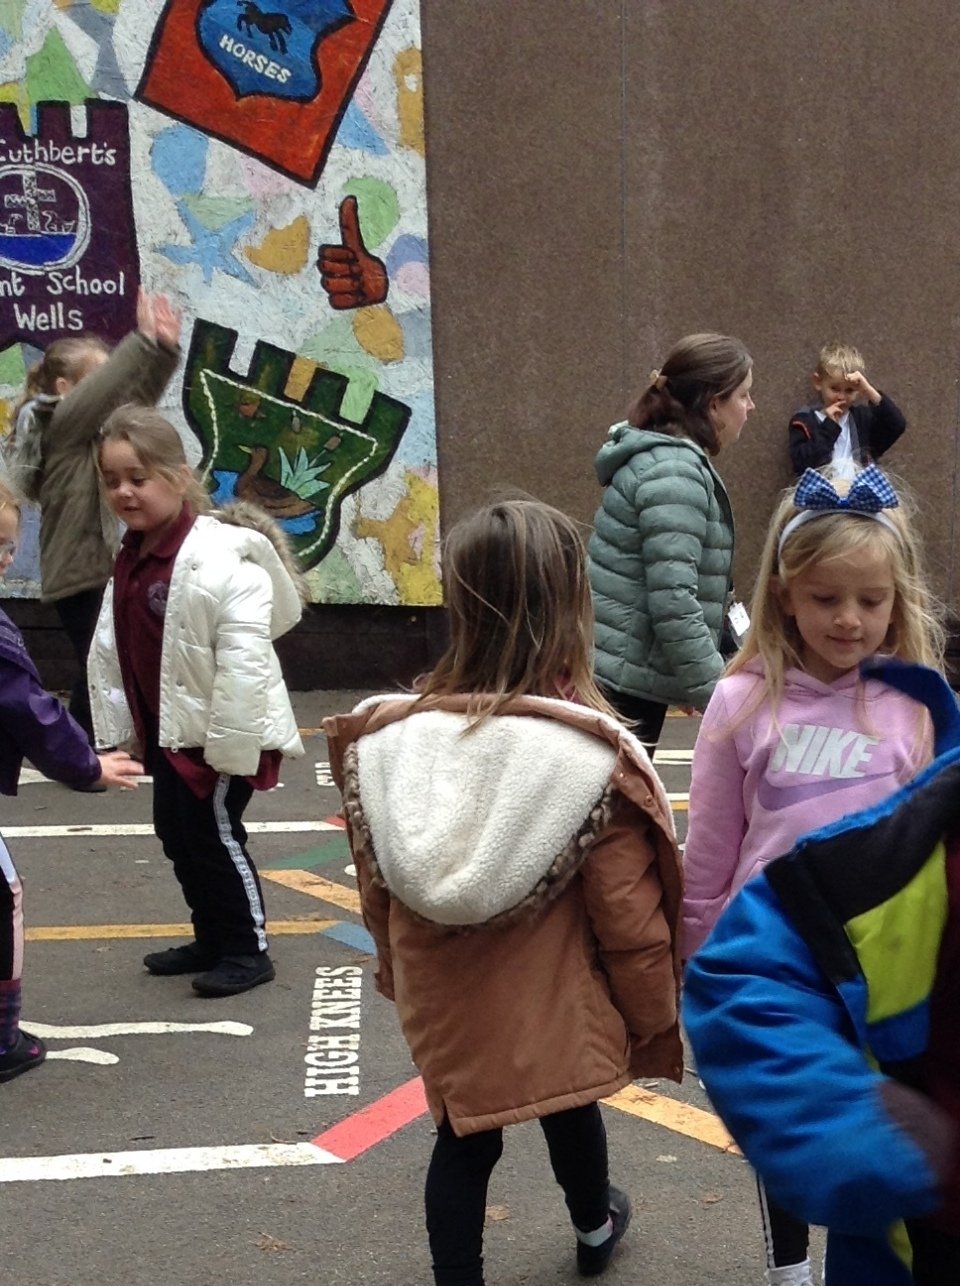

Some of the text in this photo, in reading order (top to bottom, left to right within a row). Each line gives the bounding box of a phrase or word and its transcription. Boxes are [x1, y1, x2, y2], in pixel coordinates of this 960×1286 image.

[219, 34, 292, 84] HORSES
[46, 265, 125, 296] School
[13, 302, 84, 331] Wells
[770, 723, 880, 779] NIKE
[304, 966, 363, 1098] HIGH KNEES
